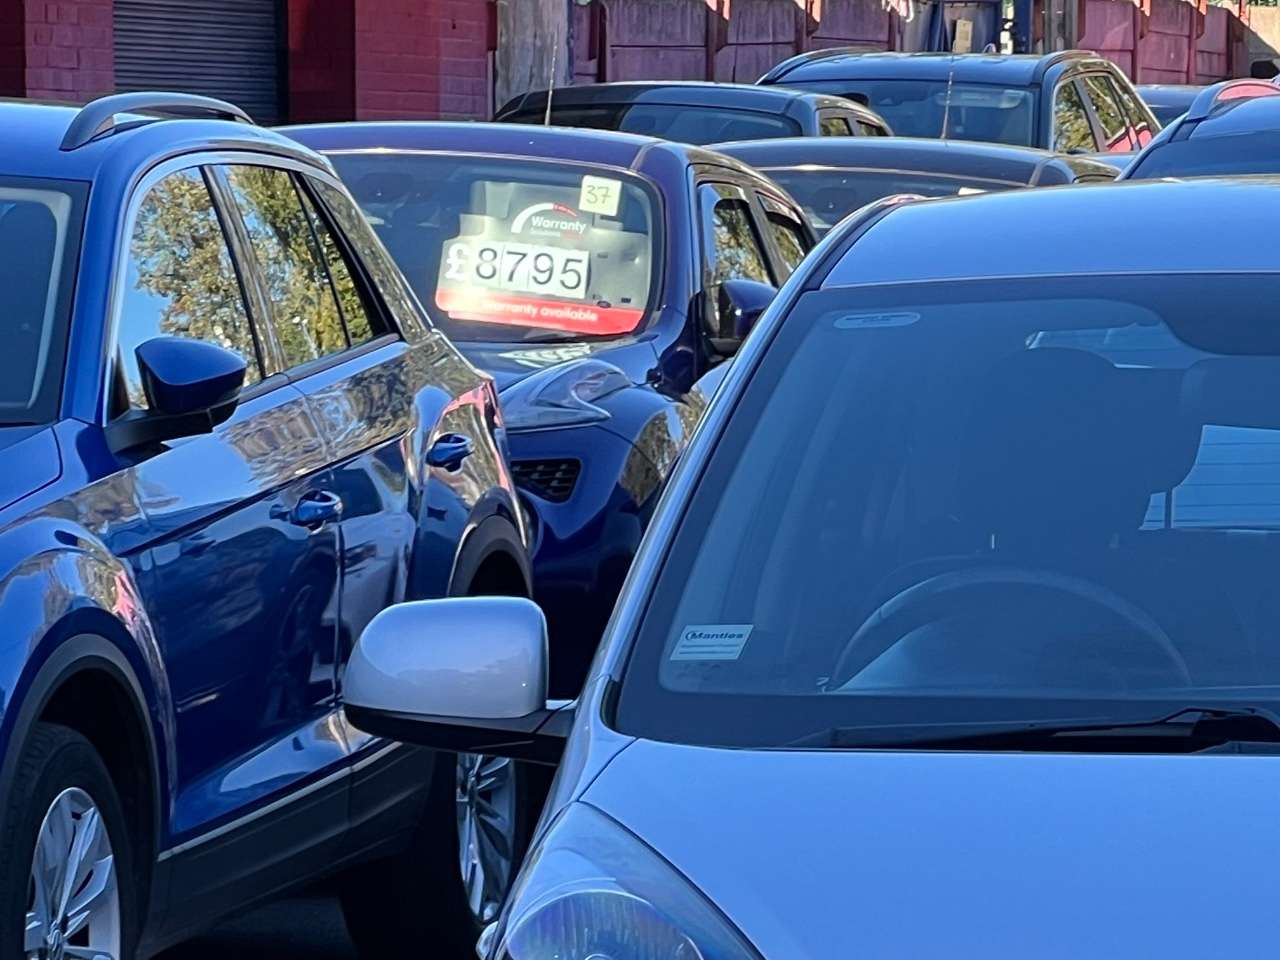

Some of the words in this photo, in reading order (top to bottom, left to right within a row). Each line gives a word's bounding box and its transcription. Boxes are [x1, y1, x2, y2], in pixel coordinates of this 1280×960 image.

[584, 184, 612, 204] 37
[531, 215, 587, 233] Warranty
[540, 306, 598, 322] available
